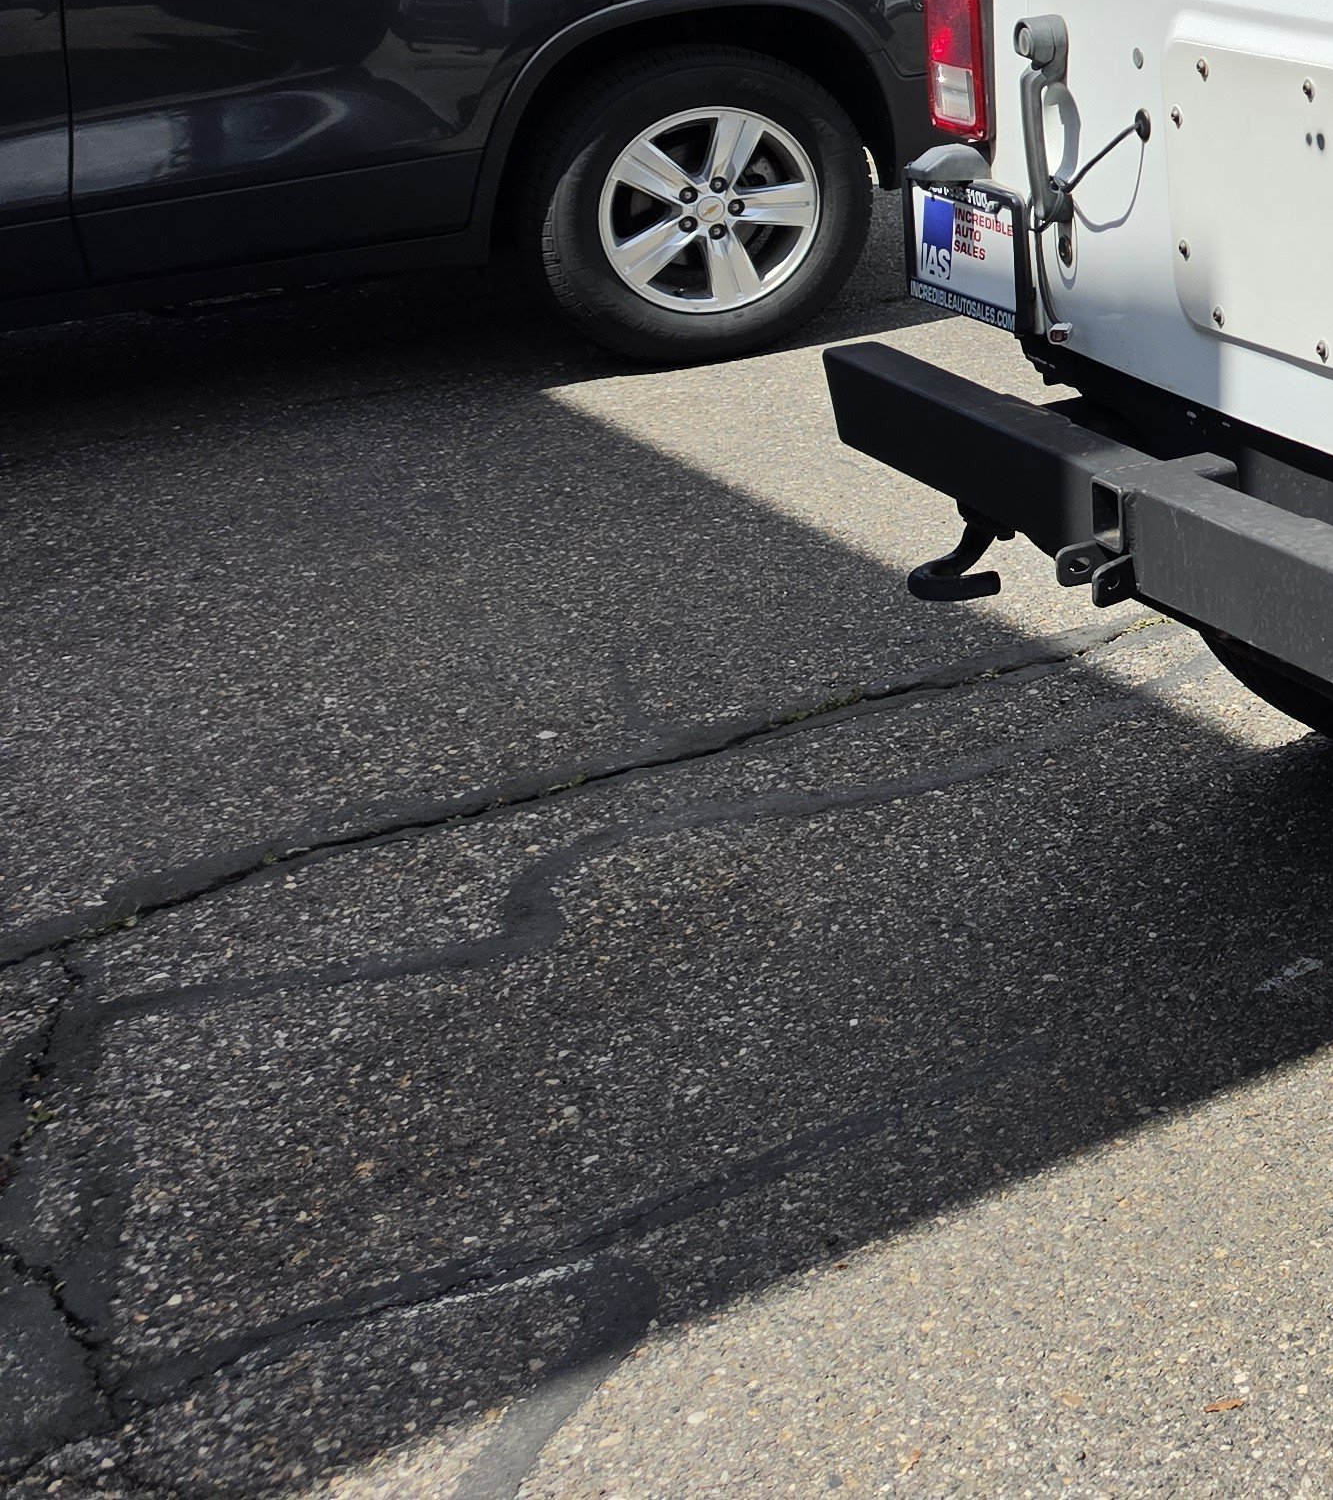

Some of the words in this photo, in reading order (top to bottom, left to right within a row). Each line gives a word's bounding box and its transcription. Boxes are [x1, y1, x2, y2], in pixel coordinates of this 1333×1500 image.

[955, 207, 1013, 236] INCREDIBLE
[955, 224, 981, 242] AUTO
[954, 240, 986, 260] SALES
[911, 280, 1016, 330] INCREDIBLEAUTOSALES.COM
